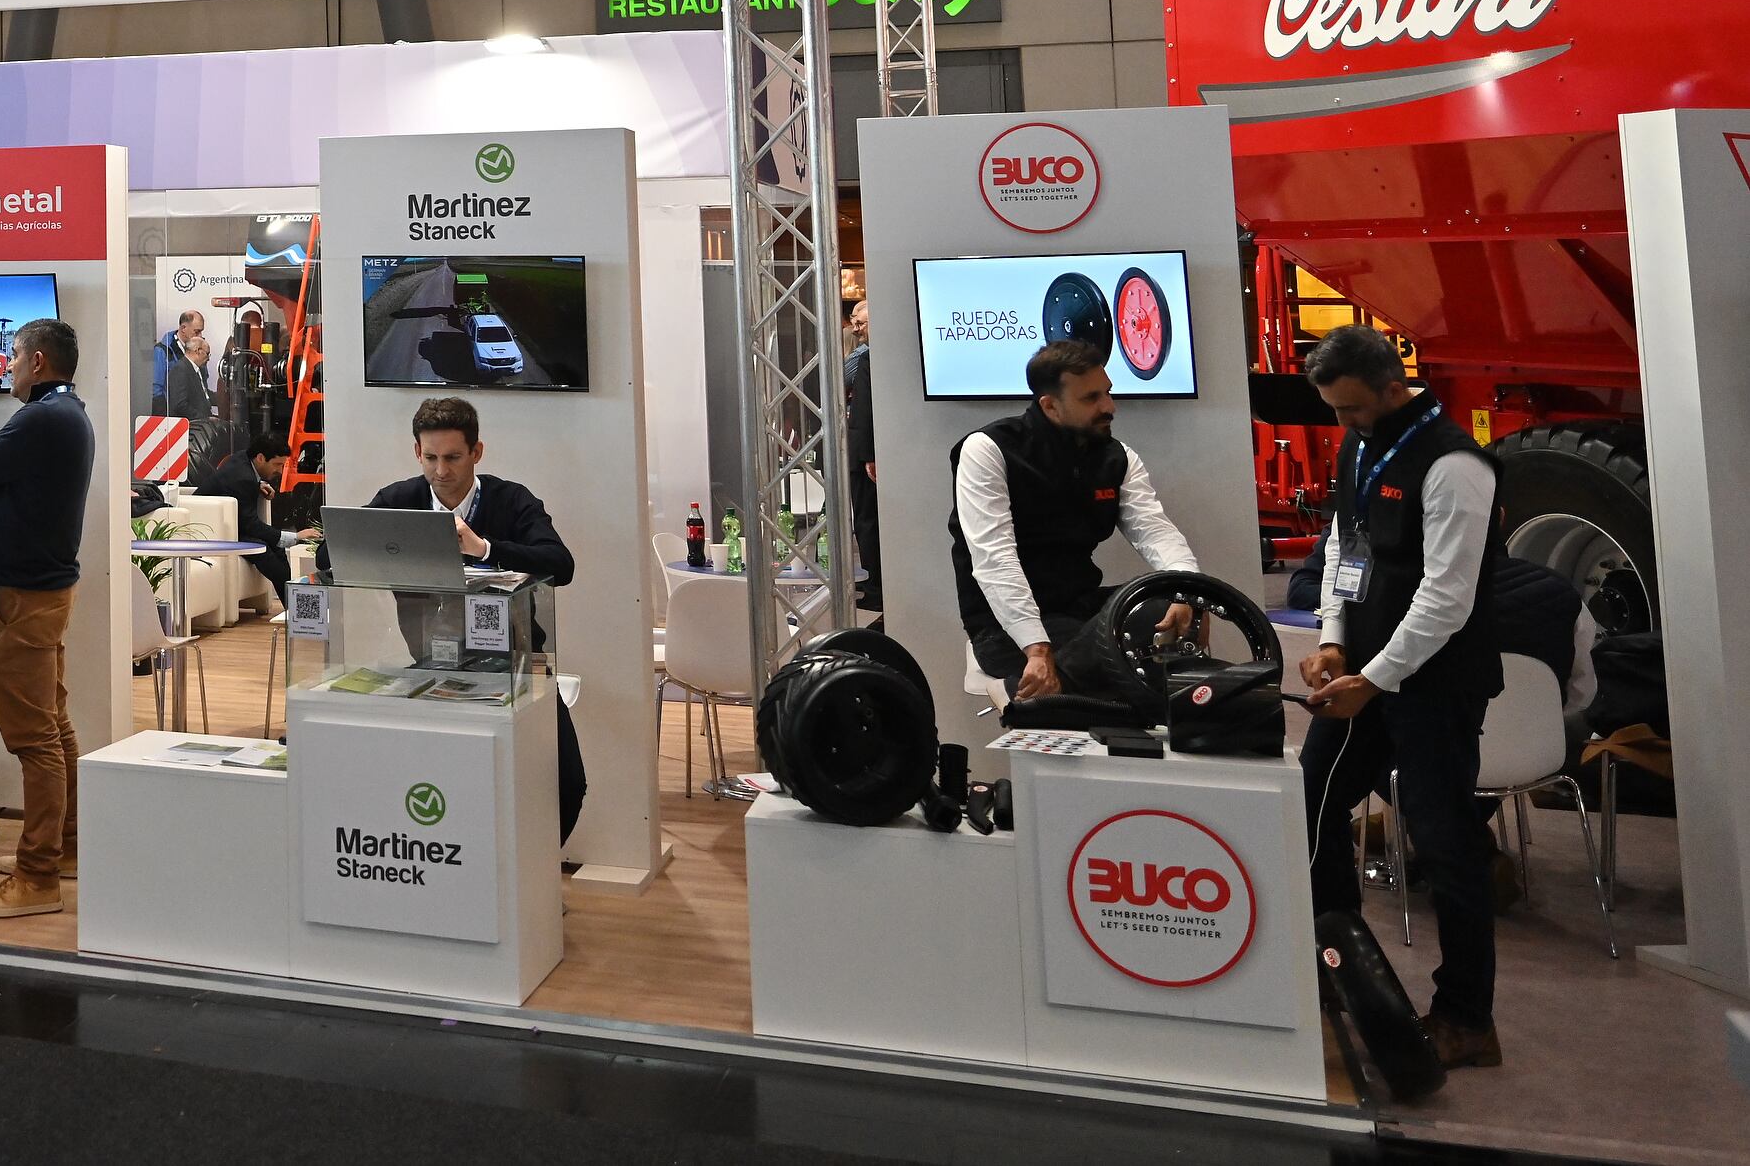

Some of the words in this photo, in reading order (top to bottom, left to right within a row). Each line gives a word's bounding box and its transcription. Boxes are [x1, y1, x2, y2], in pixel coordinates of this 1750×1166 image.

[992, 156, 1084, 186] BUCO
[408, 193, 531, 219] Martinez
[15, 221, 62, 232] Agrícolas
[409, 221, 496, 241] Staneck
[200, 275, 243, 286] Argentina
[952, 310, 1018, 326] RUEDAS
[935, 325, 1037, 341] TAPADORAS
[336, 827, 462, 866] Martinez
[336, 857, 425, 886] Staneck
[1088, 858, 1231, 913] BUCO
[1101, 909, 1170, 922] SEMBREMOS
[1174, 916, 1216, 926] JUNTOS
[1101, 921, 1128, 930] LET'S
[1133, 924, 1159, 933] SEED
[1164, 926, 1221, 939] TOGETHER
